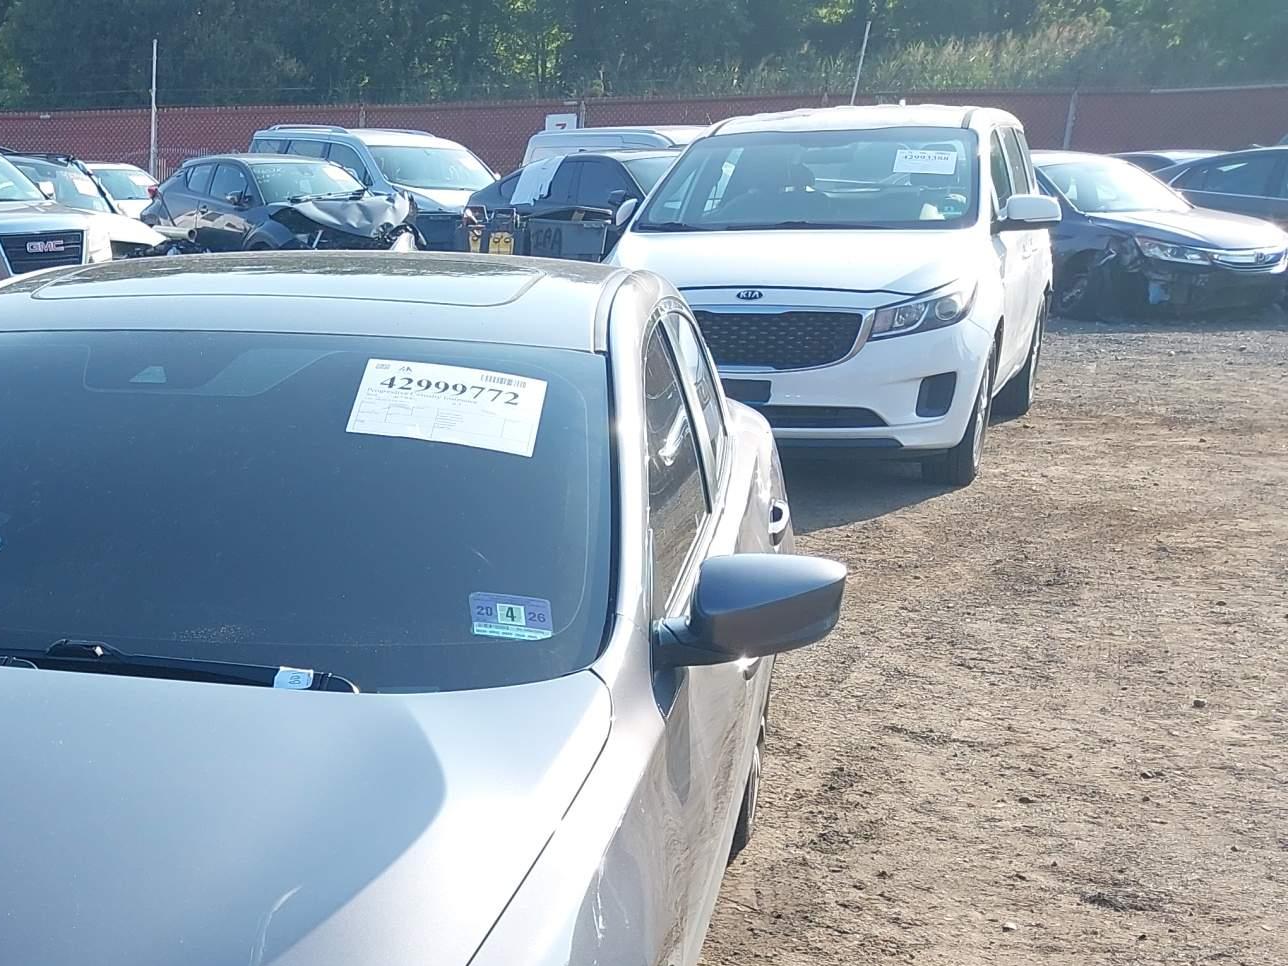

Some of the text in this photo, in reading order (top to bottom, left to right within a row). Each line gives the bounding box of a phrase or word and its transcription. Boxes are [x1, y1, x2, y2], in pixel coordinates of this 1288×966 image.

[26, 239, 64, 253] GMC
[739, 290, 760, 299] KIA
[379, 375, 520, 406] 42999772
[476, 606, 546, 622] 20 4 26
